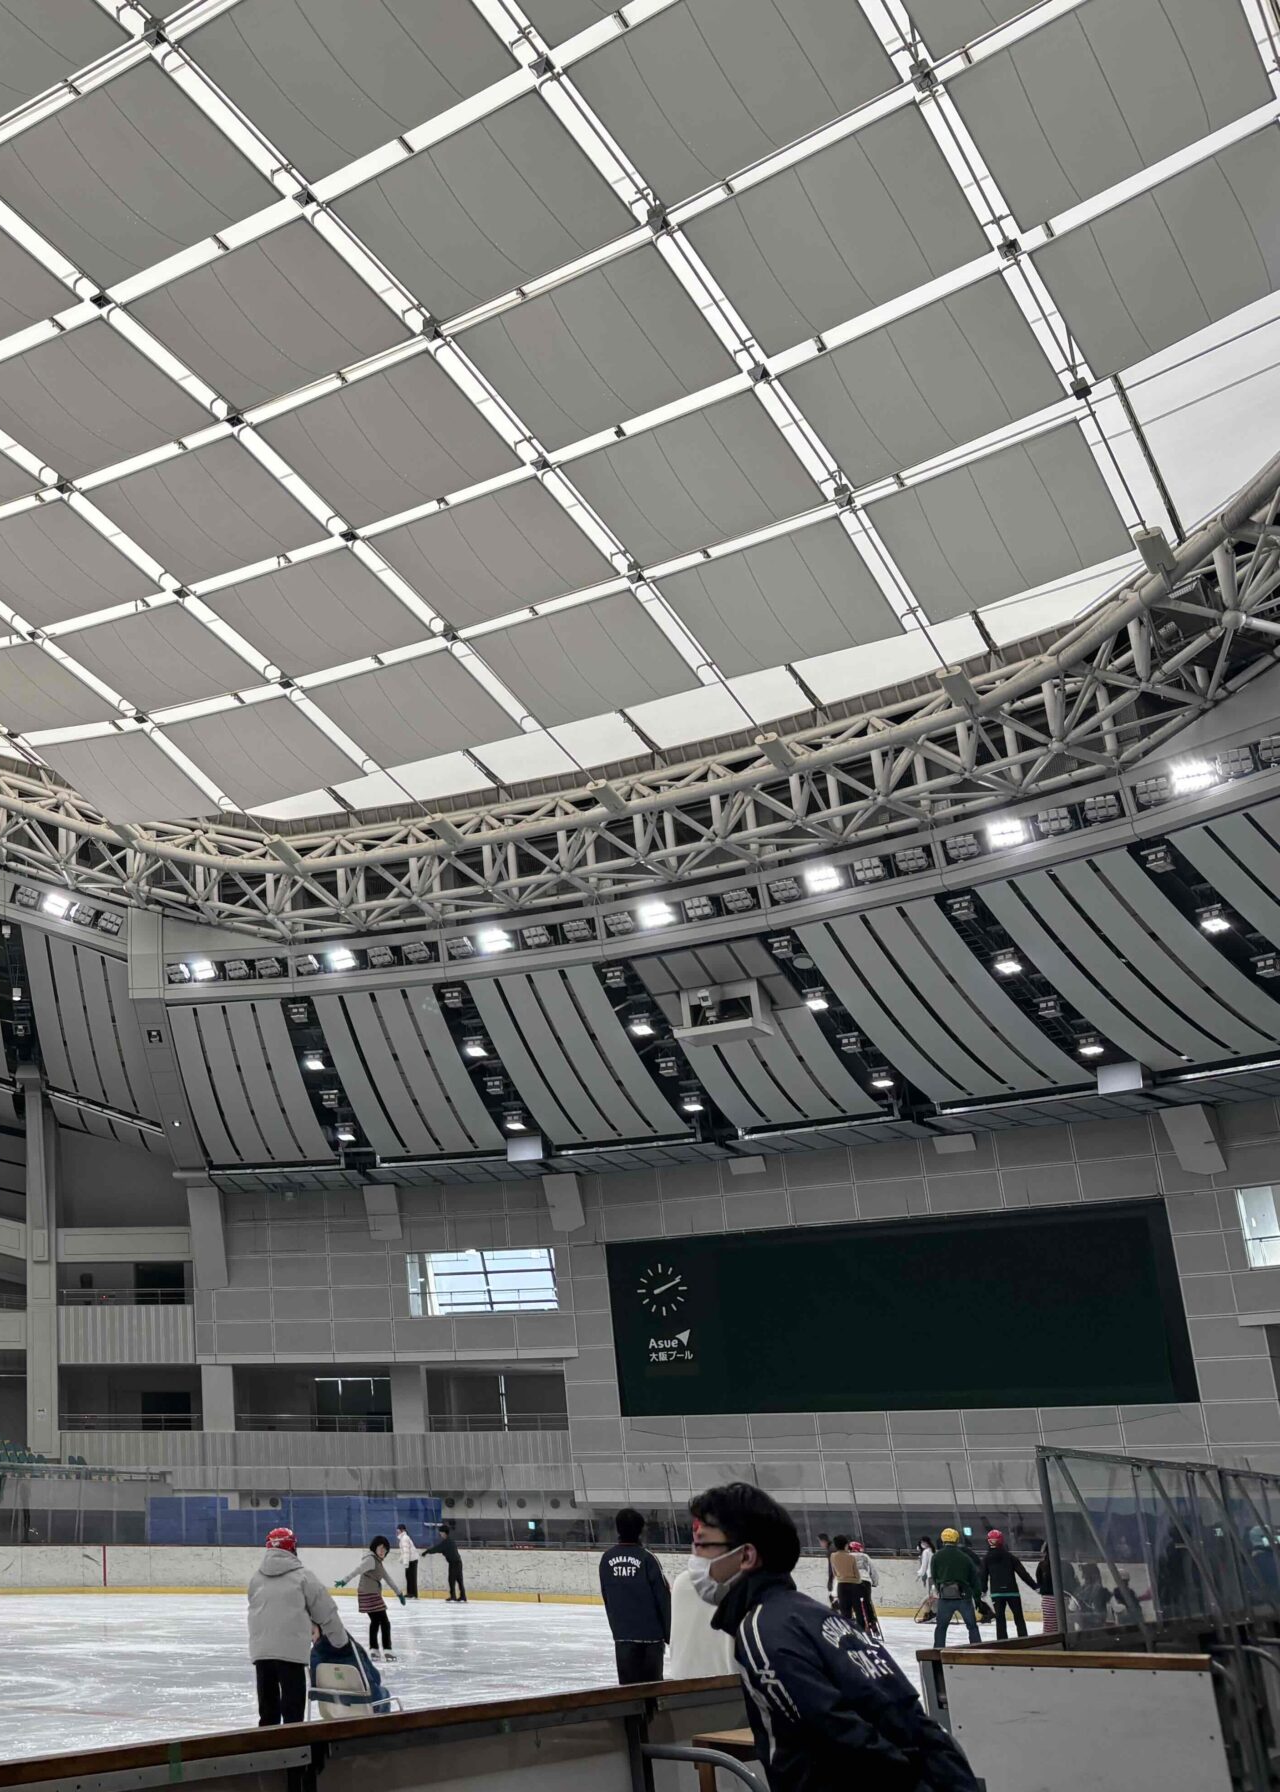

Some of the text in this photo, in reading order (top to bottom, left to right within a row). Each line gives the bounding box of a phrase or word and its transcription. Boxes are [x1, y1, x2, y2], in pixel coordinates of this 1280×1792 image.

[648, 1338, 679, 1349] Asue
[649, 1350, 694, 1362] 大阪プール
[608, 1556, 642, 1569] OSAKA POOL
[613, 1566, 637, 1577] STAFF
